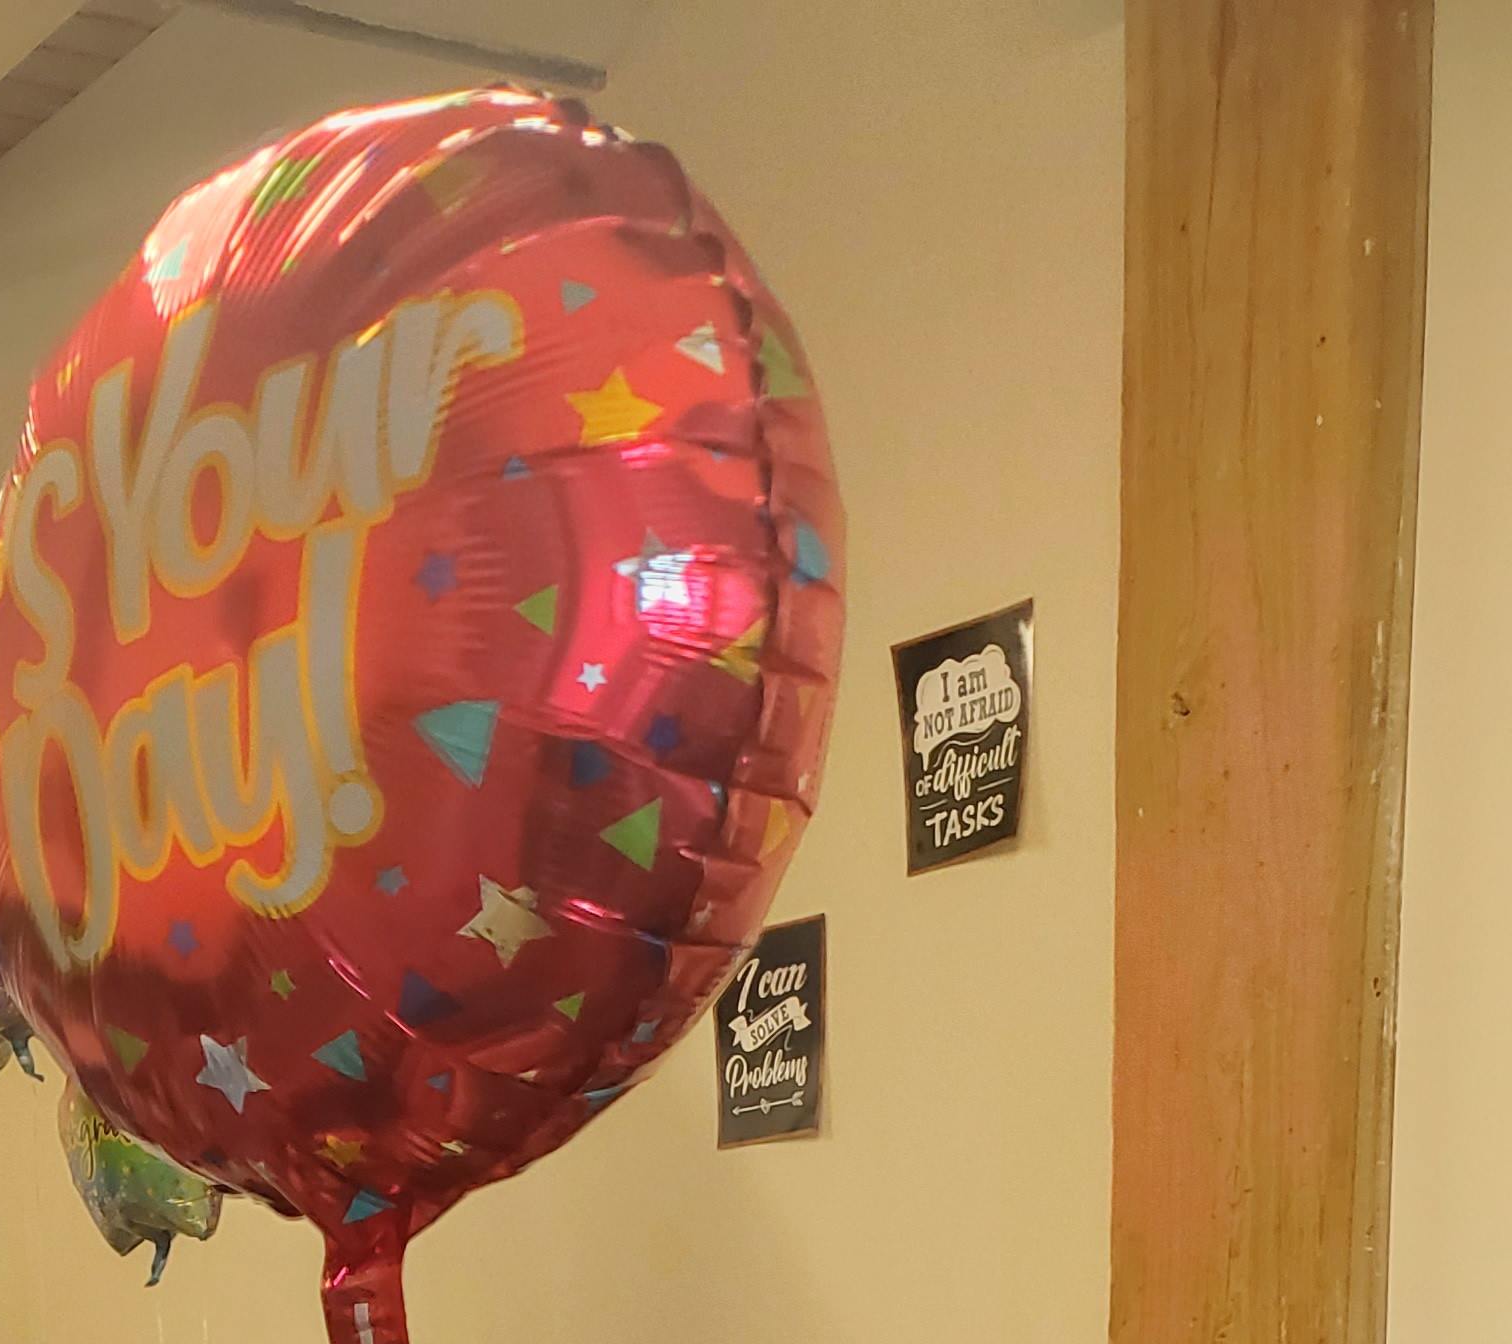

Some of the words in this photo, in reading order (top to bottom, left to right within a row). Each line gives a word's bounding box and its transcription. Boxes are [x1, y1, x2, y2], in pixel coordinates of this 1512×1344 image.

[92, 290, 525, 643] Your
[922, 707, 955, 740] NOT
[958, 686, 1014, 728] AFRAID
[940, 671, 951, 703] I
[957, 667, 988, 698] am
[0, 527, 384, 974] Day!
[915, 774, 933, 798] OF
[932, 723, 1022, 801] difficult
[925, 793, 1005, 849] TASKS
[736, 957, 760, 1014] I
[757, 962, 809, 999] can
[749, 1003, 790, 1046] SOLVE
[724, 1048, 808, 1099] Problems
